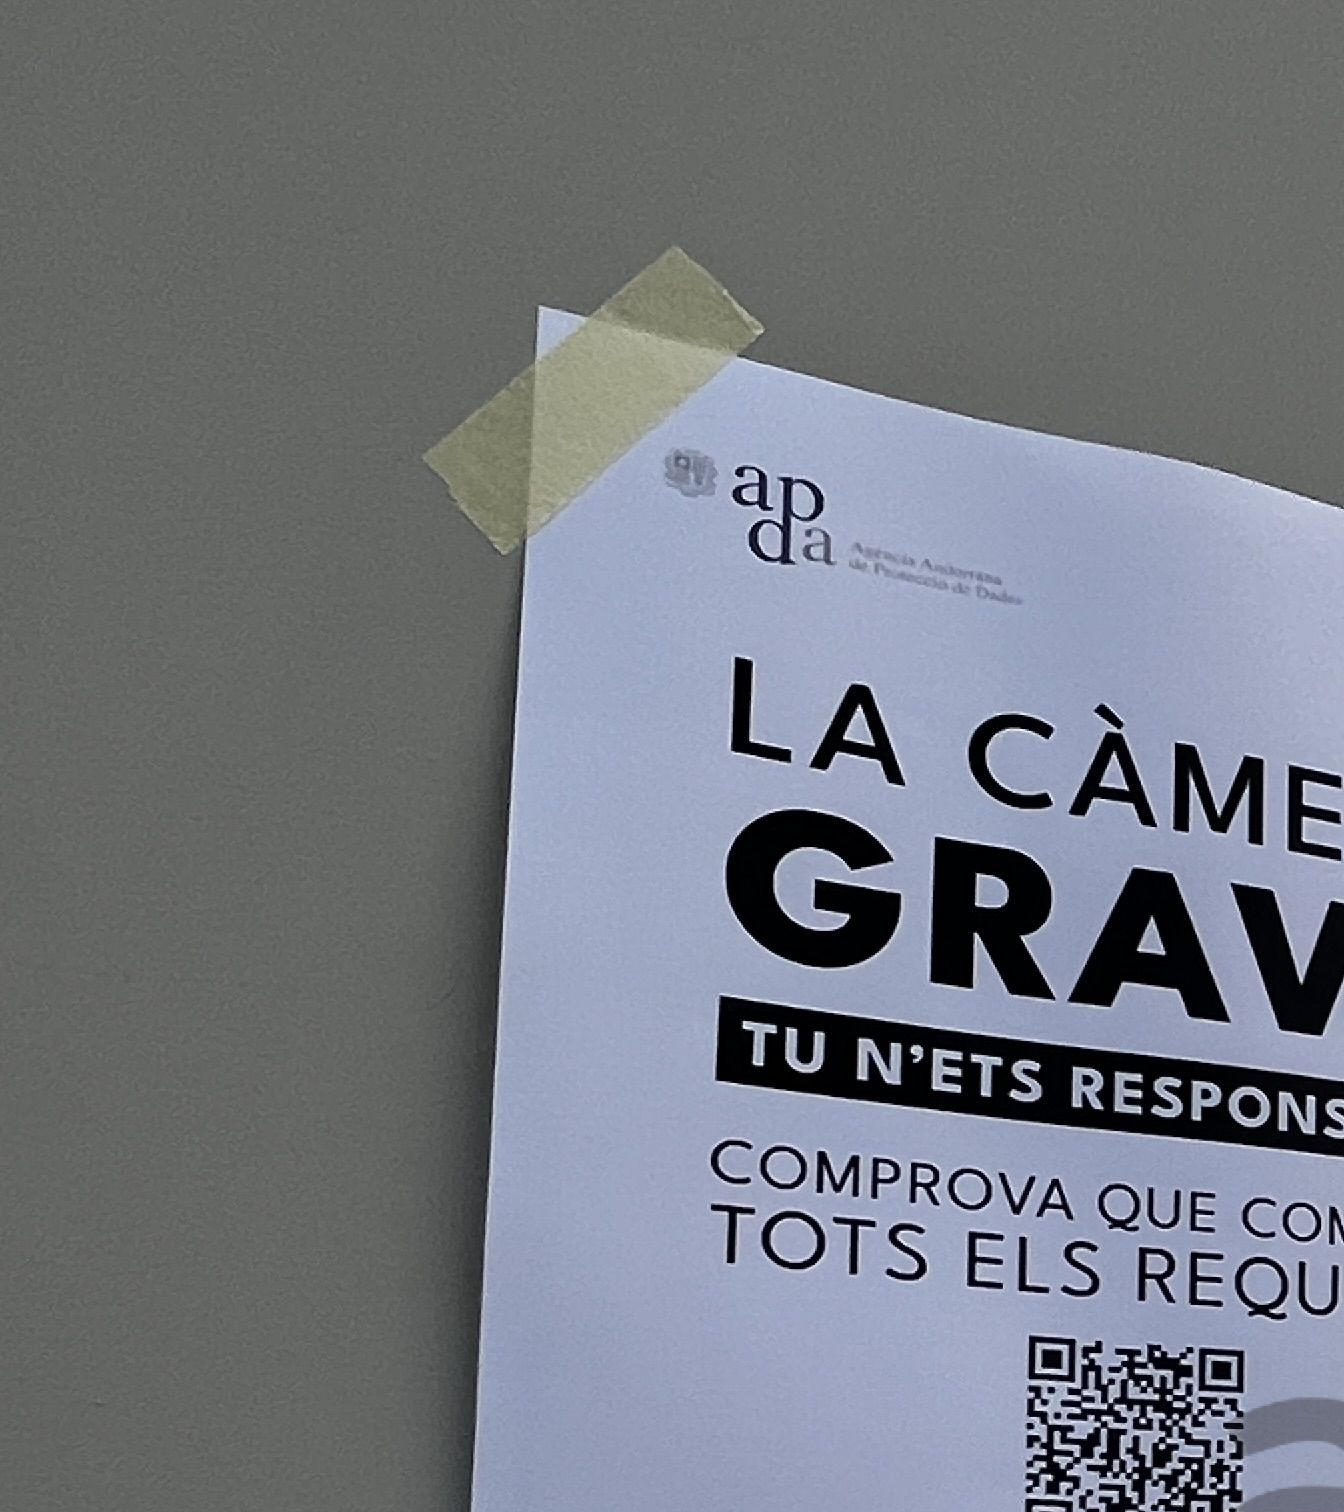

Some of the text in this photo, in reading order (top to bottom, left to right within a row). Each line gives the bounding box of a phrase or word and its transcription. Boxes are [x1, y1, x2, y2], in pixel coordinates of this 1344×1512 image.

[731, 656, 906, 787] LA
[742, 1019, 826, 1074] TU
[856, 1036, 1042, 1104] N'ETS
[710, 1139, 1074, 1221] COMPROVA
[1098, 1183, 1217, 1234] QUE
[710, 1204, 928, 1281] TOTS
[965, 1231, 1102, 1297] ELS
